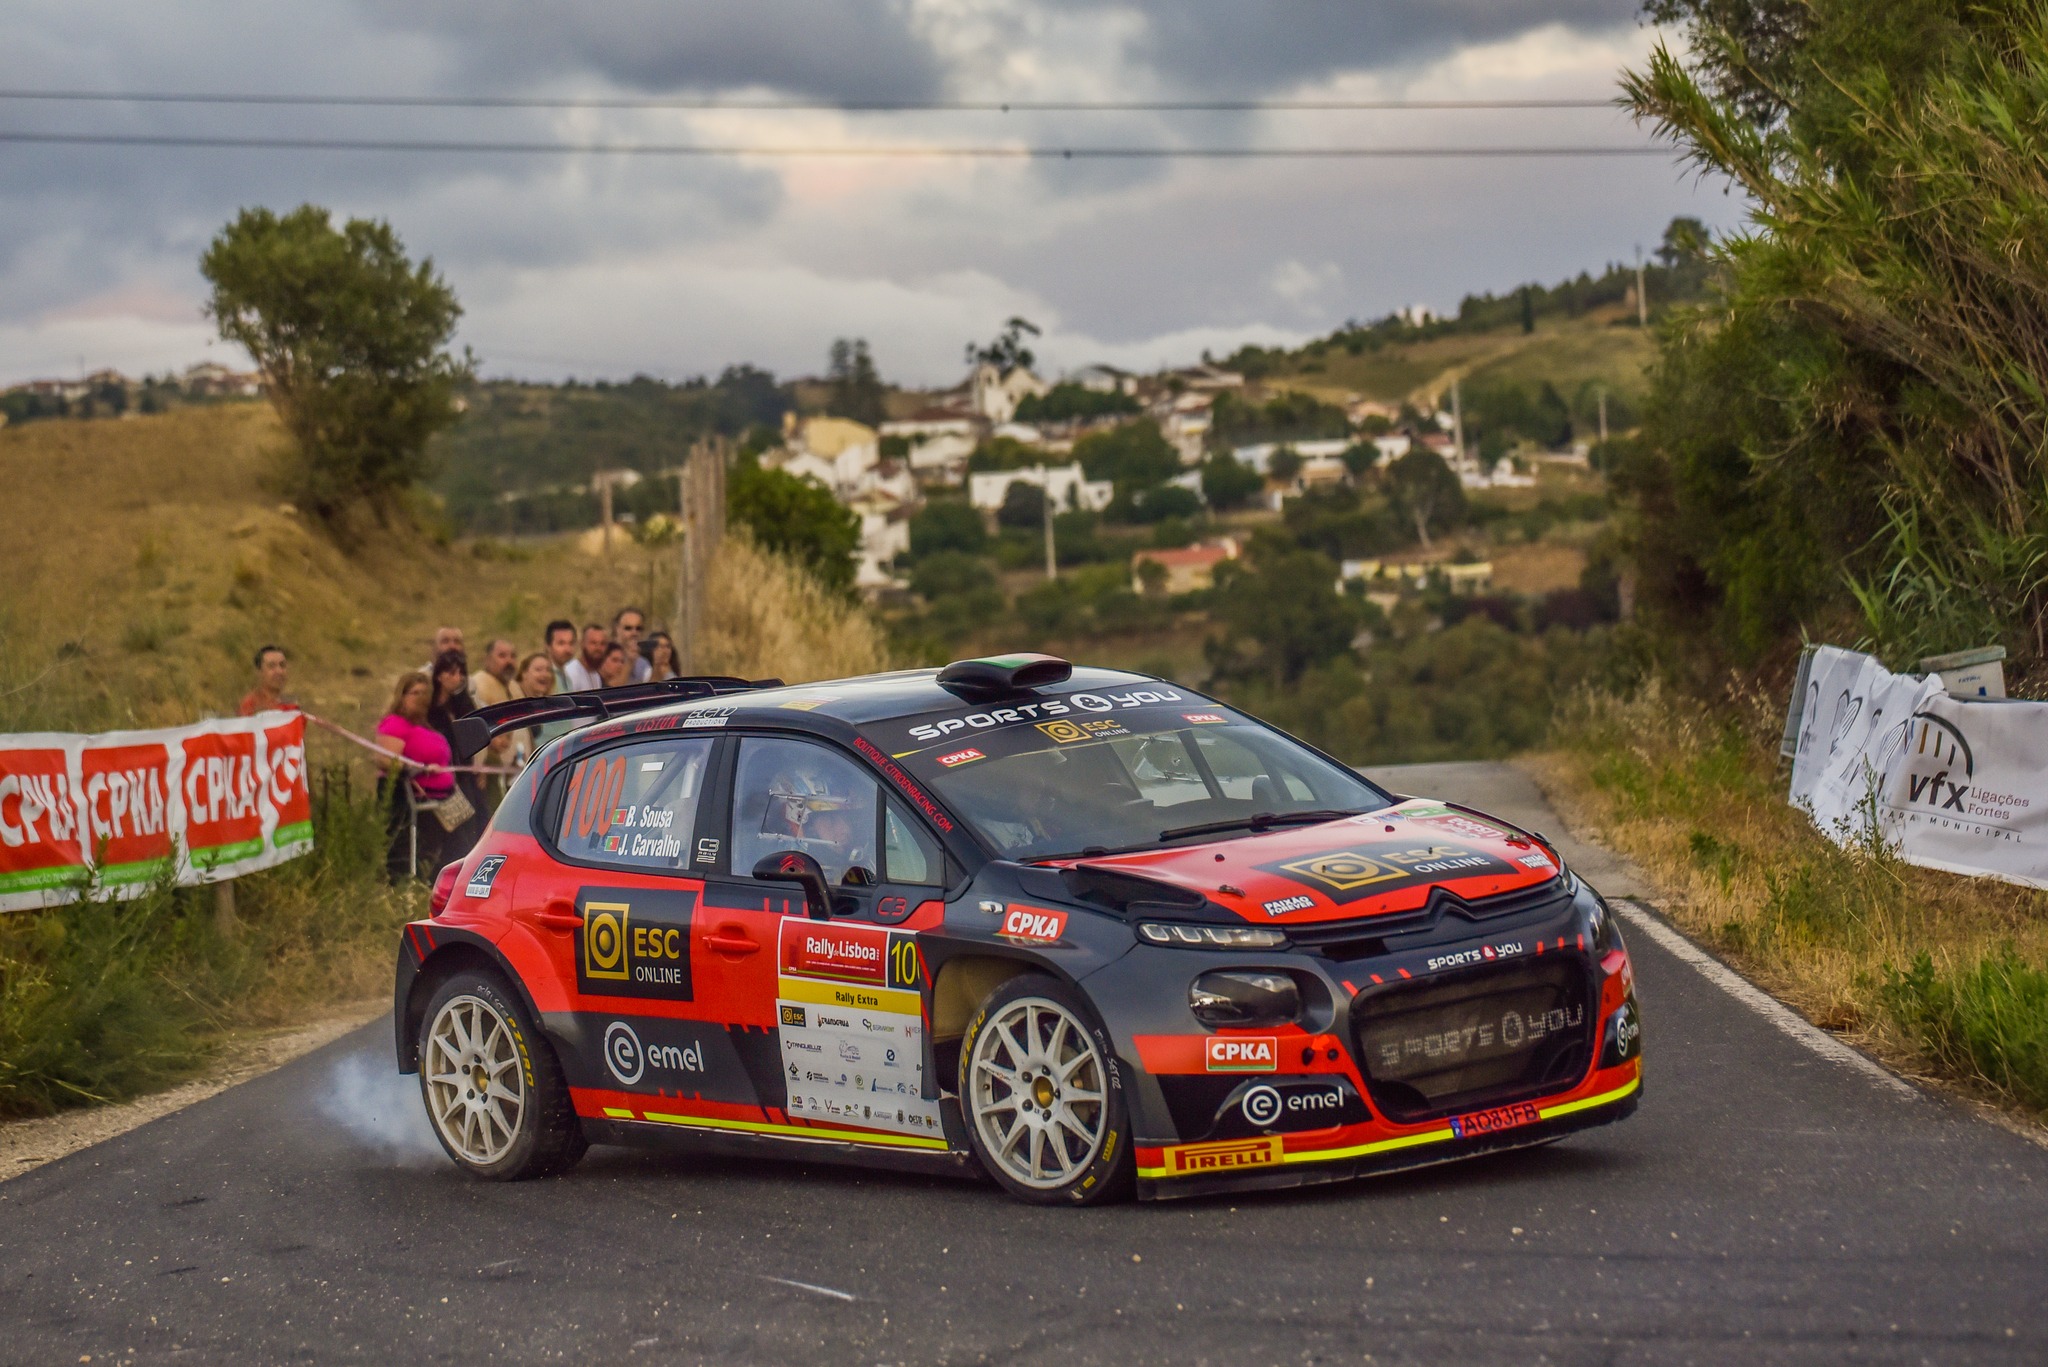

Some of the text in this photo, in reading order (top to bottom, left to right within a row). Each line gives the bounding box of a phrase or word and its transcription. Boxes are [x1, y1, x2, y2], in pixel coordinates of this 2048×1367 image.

[908, 700, 1070, 741] SPORTS
[1081, 719, 1121, 731] ESC
[1095, 728, 1131, 738] ONLINE
[853, 737, 888, 767] BOUTIQUE
[942, 750, 981, 764] CPKA
[186, 755, 258, 825] CPKA
[563, 754, 627, 839] 100
[1909, 771, 1970, 813] vfx
[1971, 787, 2030, 807] Ligações
[87, 767, 166, 839] CPKA
[1968, 803, 2010, 820] Fortes
[625, 805, 674, 828] B. Sousa
[1929, 816, 2022, 843] MUNICIPAL
[618, 834, 681, 857] J. Carvalho
[1381, 846, 1468, 864] ESC
[1414, 856, 1490, 874] ONLINE
[877, 897, 907, 916] C3
[1007, 911, 1059, 938] CPKA
[634, 927, 680, 960] ESC
[806, 937, 835, 959] Rally
[839, 941, 876, 960] Lisboa
[1427, 949, 1482, 970] SPORTS
[635, 965, 682, 984] ONLINE
[835, 991, 878, 1006] Rally Extra
[647, 1040, 704, 1073] emel
[1211, 1043, 1271, 1060] CPKA
[1287, 1086, 1344, 1110] emel
[1175, 1141, 1271, 1171] PIRELLI
